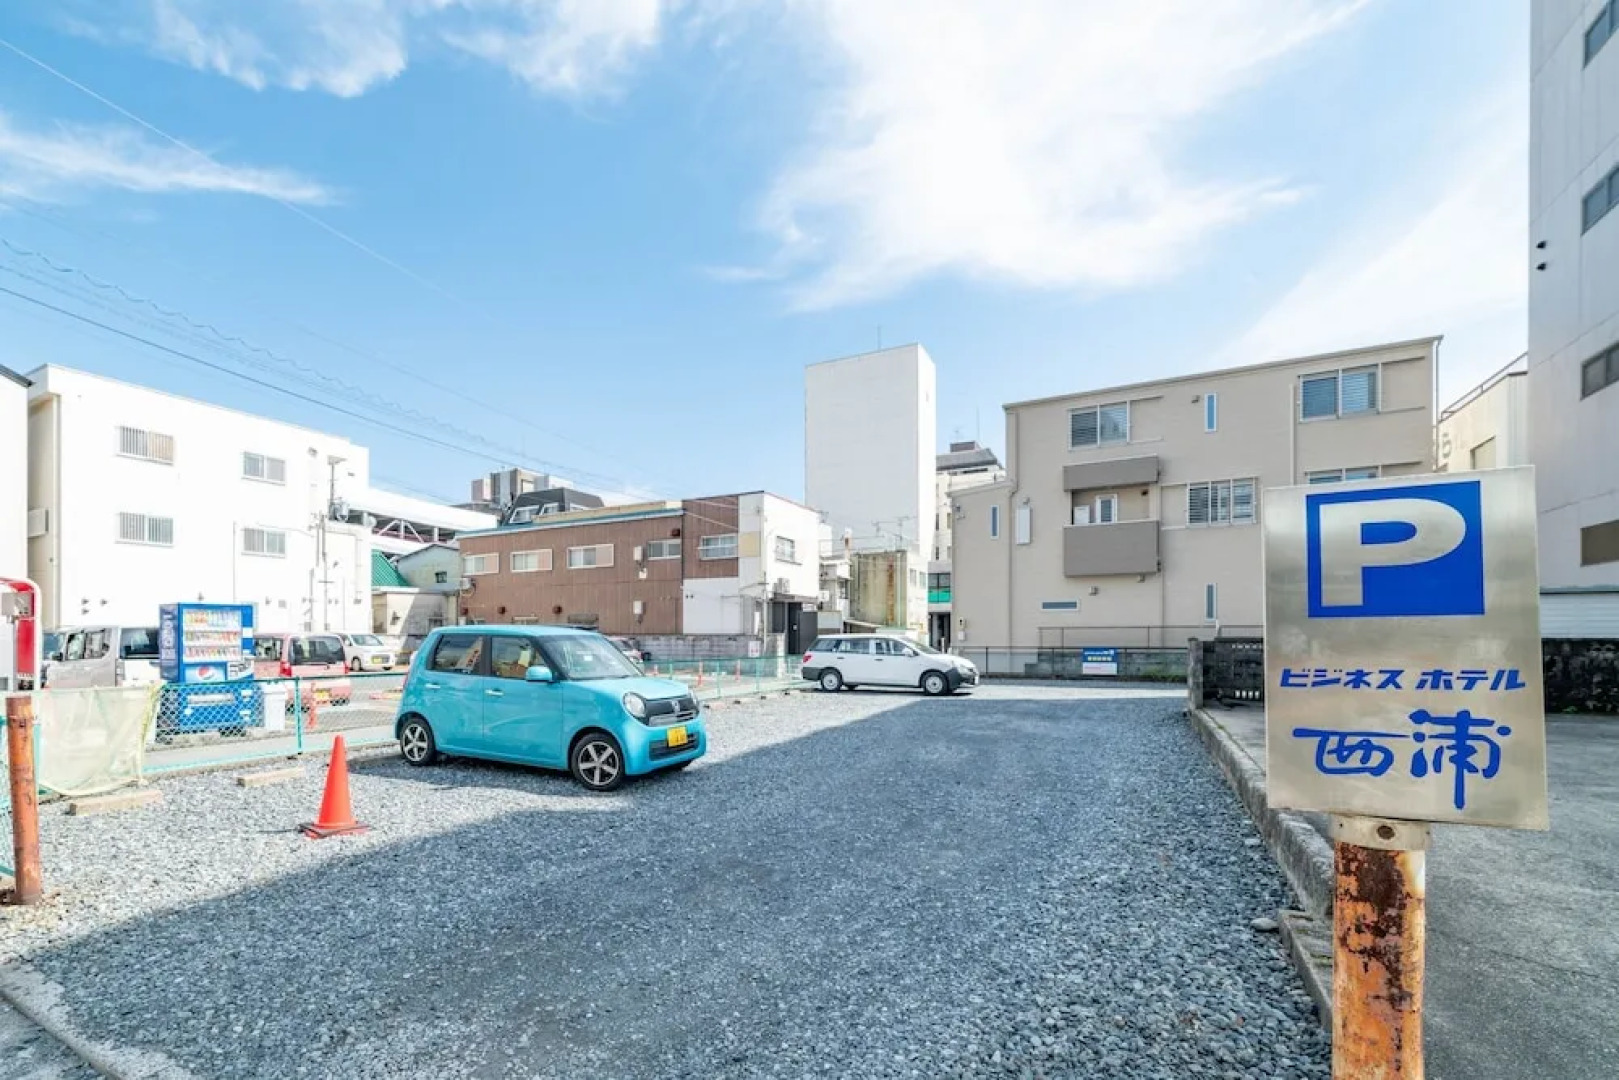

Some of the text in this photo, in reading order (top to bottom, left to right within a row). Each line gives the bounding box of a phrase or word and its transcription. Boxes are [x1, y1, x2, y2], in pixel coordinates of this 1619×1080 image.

[1319, 498, 1467, 608] P
[1280, 668, 1526, 691] ビジネス ホテル
[1292, 709, 1512, 811] 西浦
